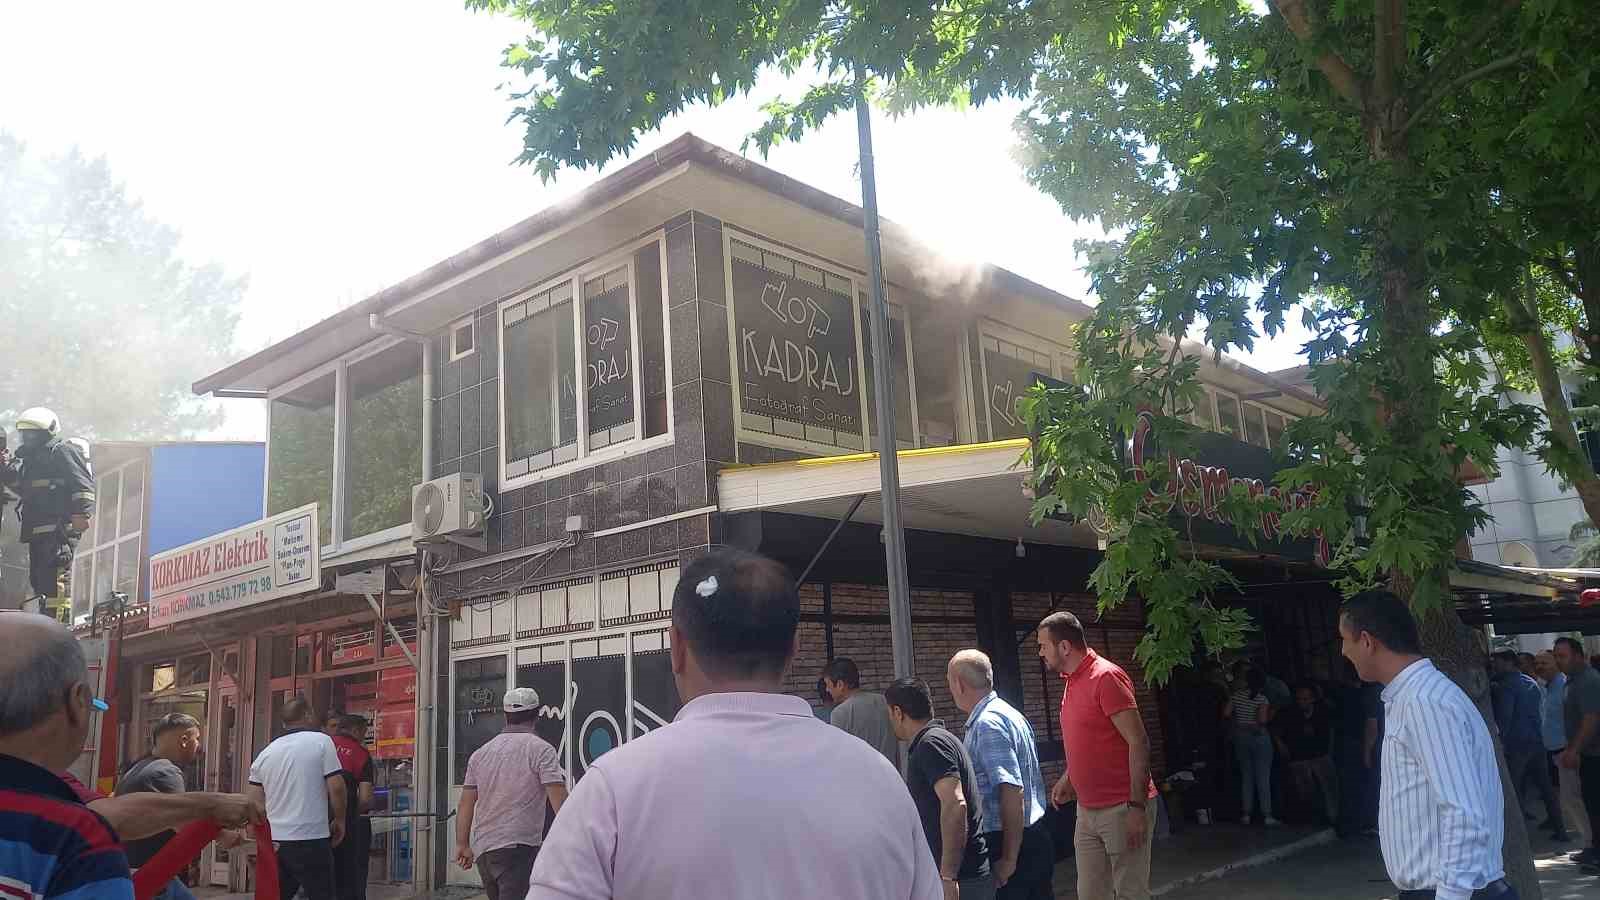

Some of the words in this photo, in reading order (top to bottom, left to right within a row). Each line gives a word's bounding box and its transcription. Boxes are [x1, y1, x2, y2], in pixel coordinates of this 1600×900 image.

[742, 327, 854, 396] KADRAJ
[151, 547, 211, 592] KORKMAZ
[213, 530, 269, 573] Elektrik
[260, 575, 272, 592] 98
